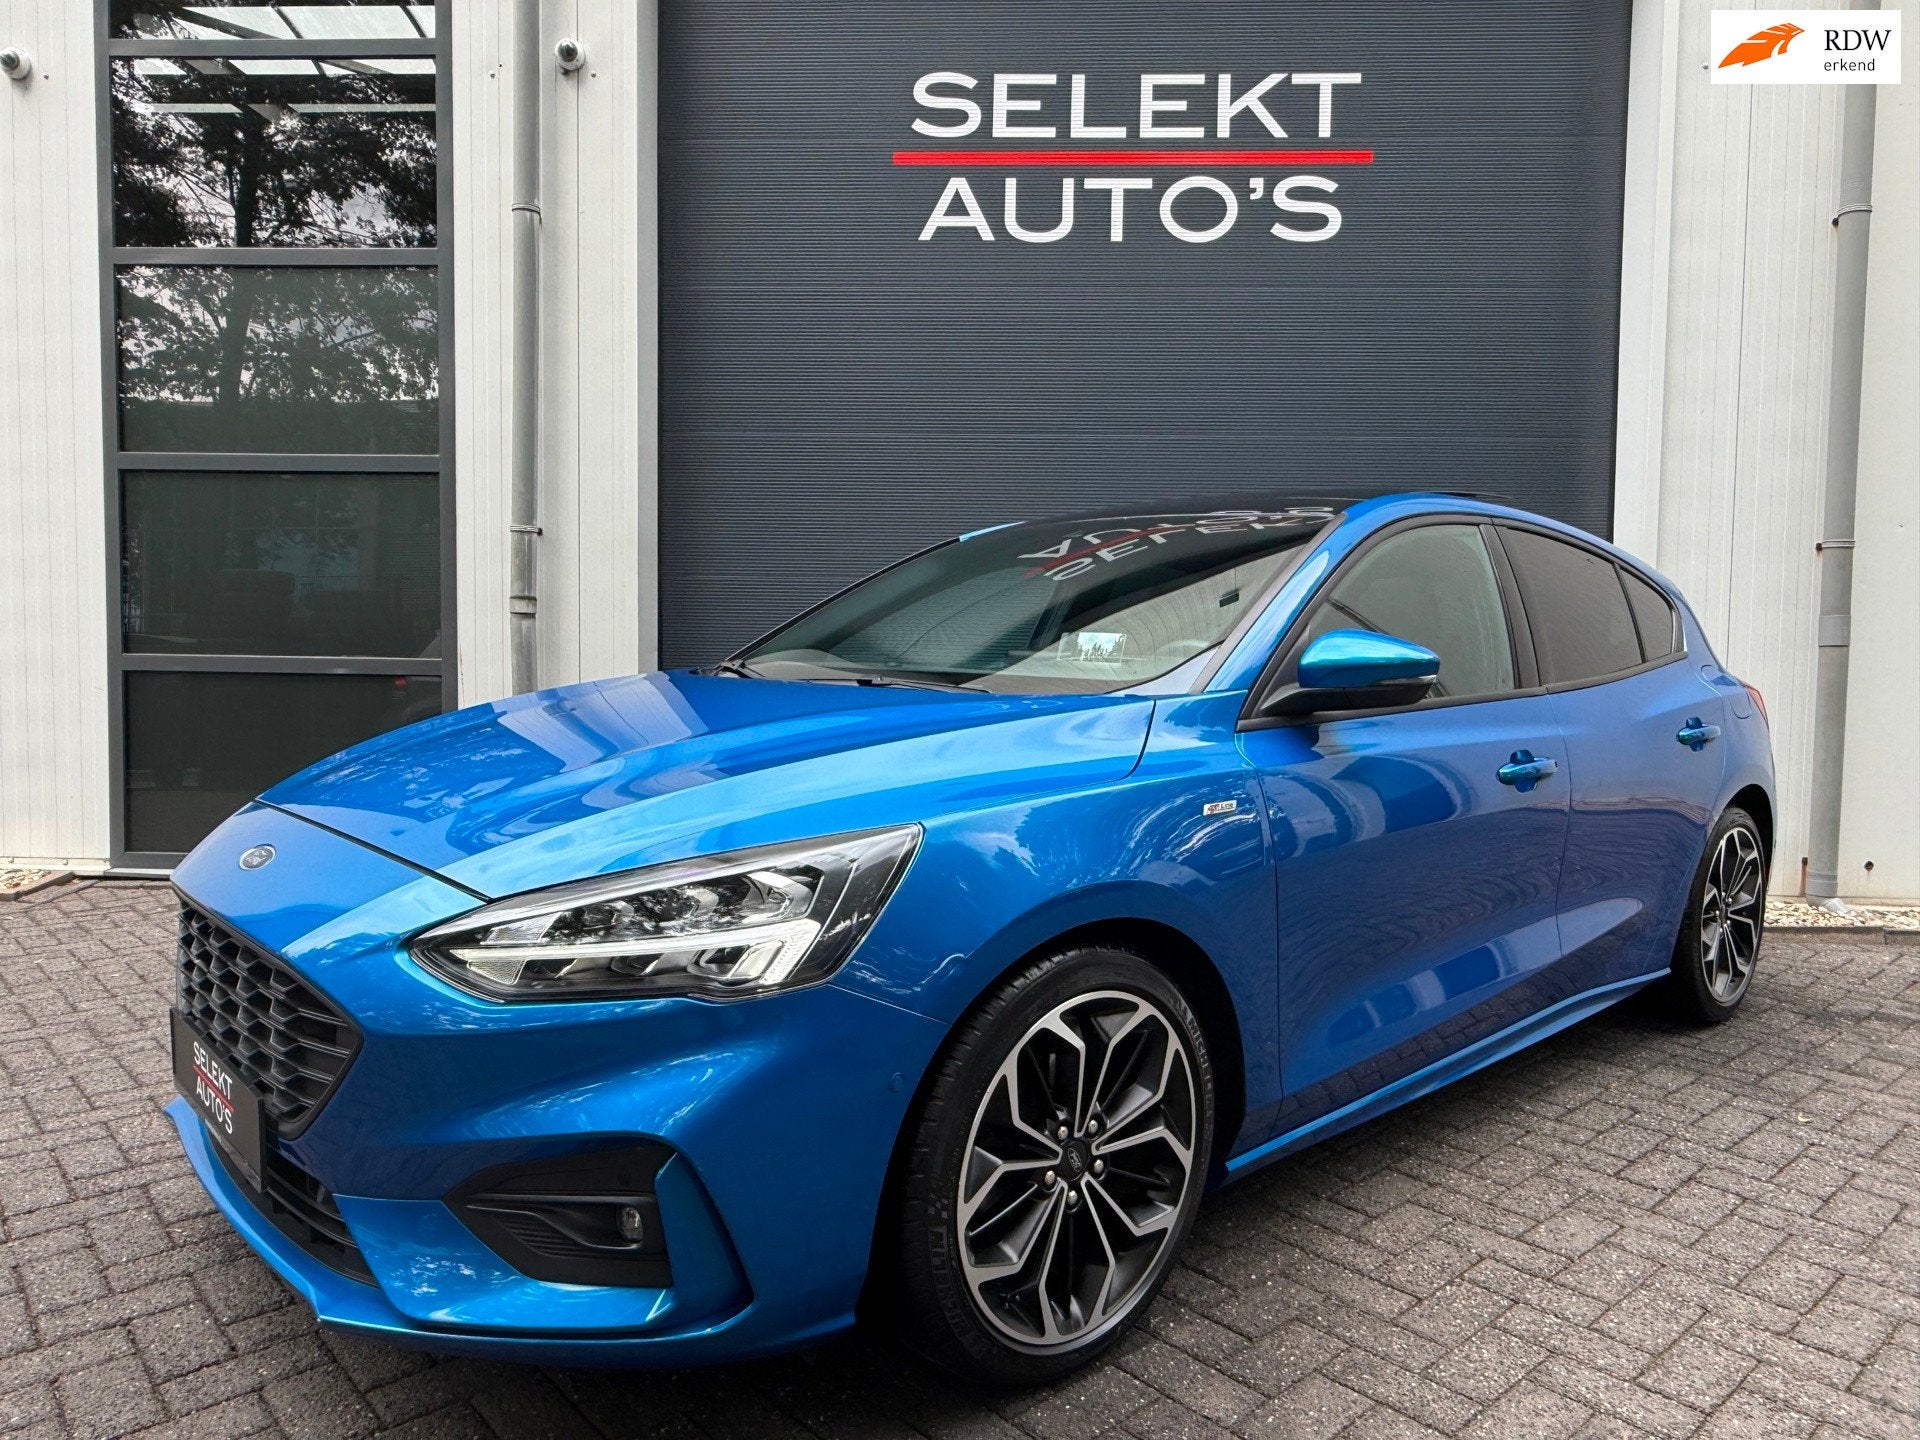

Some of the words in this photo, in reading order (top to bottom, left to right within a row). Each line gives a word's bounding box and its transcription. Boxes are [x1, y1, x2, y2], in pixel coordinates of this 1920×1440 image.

[911, 71, 1362, 138] SELEKT
[918, 175, 1342, 243] AUTO'S
[193, 1041, 233, 1100] SELEKT
[196, 1076, 233, 1135] AUTO'S
